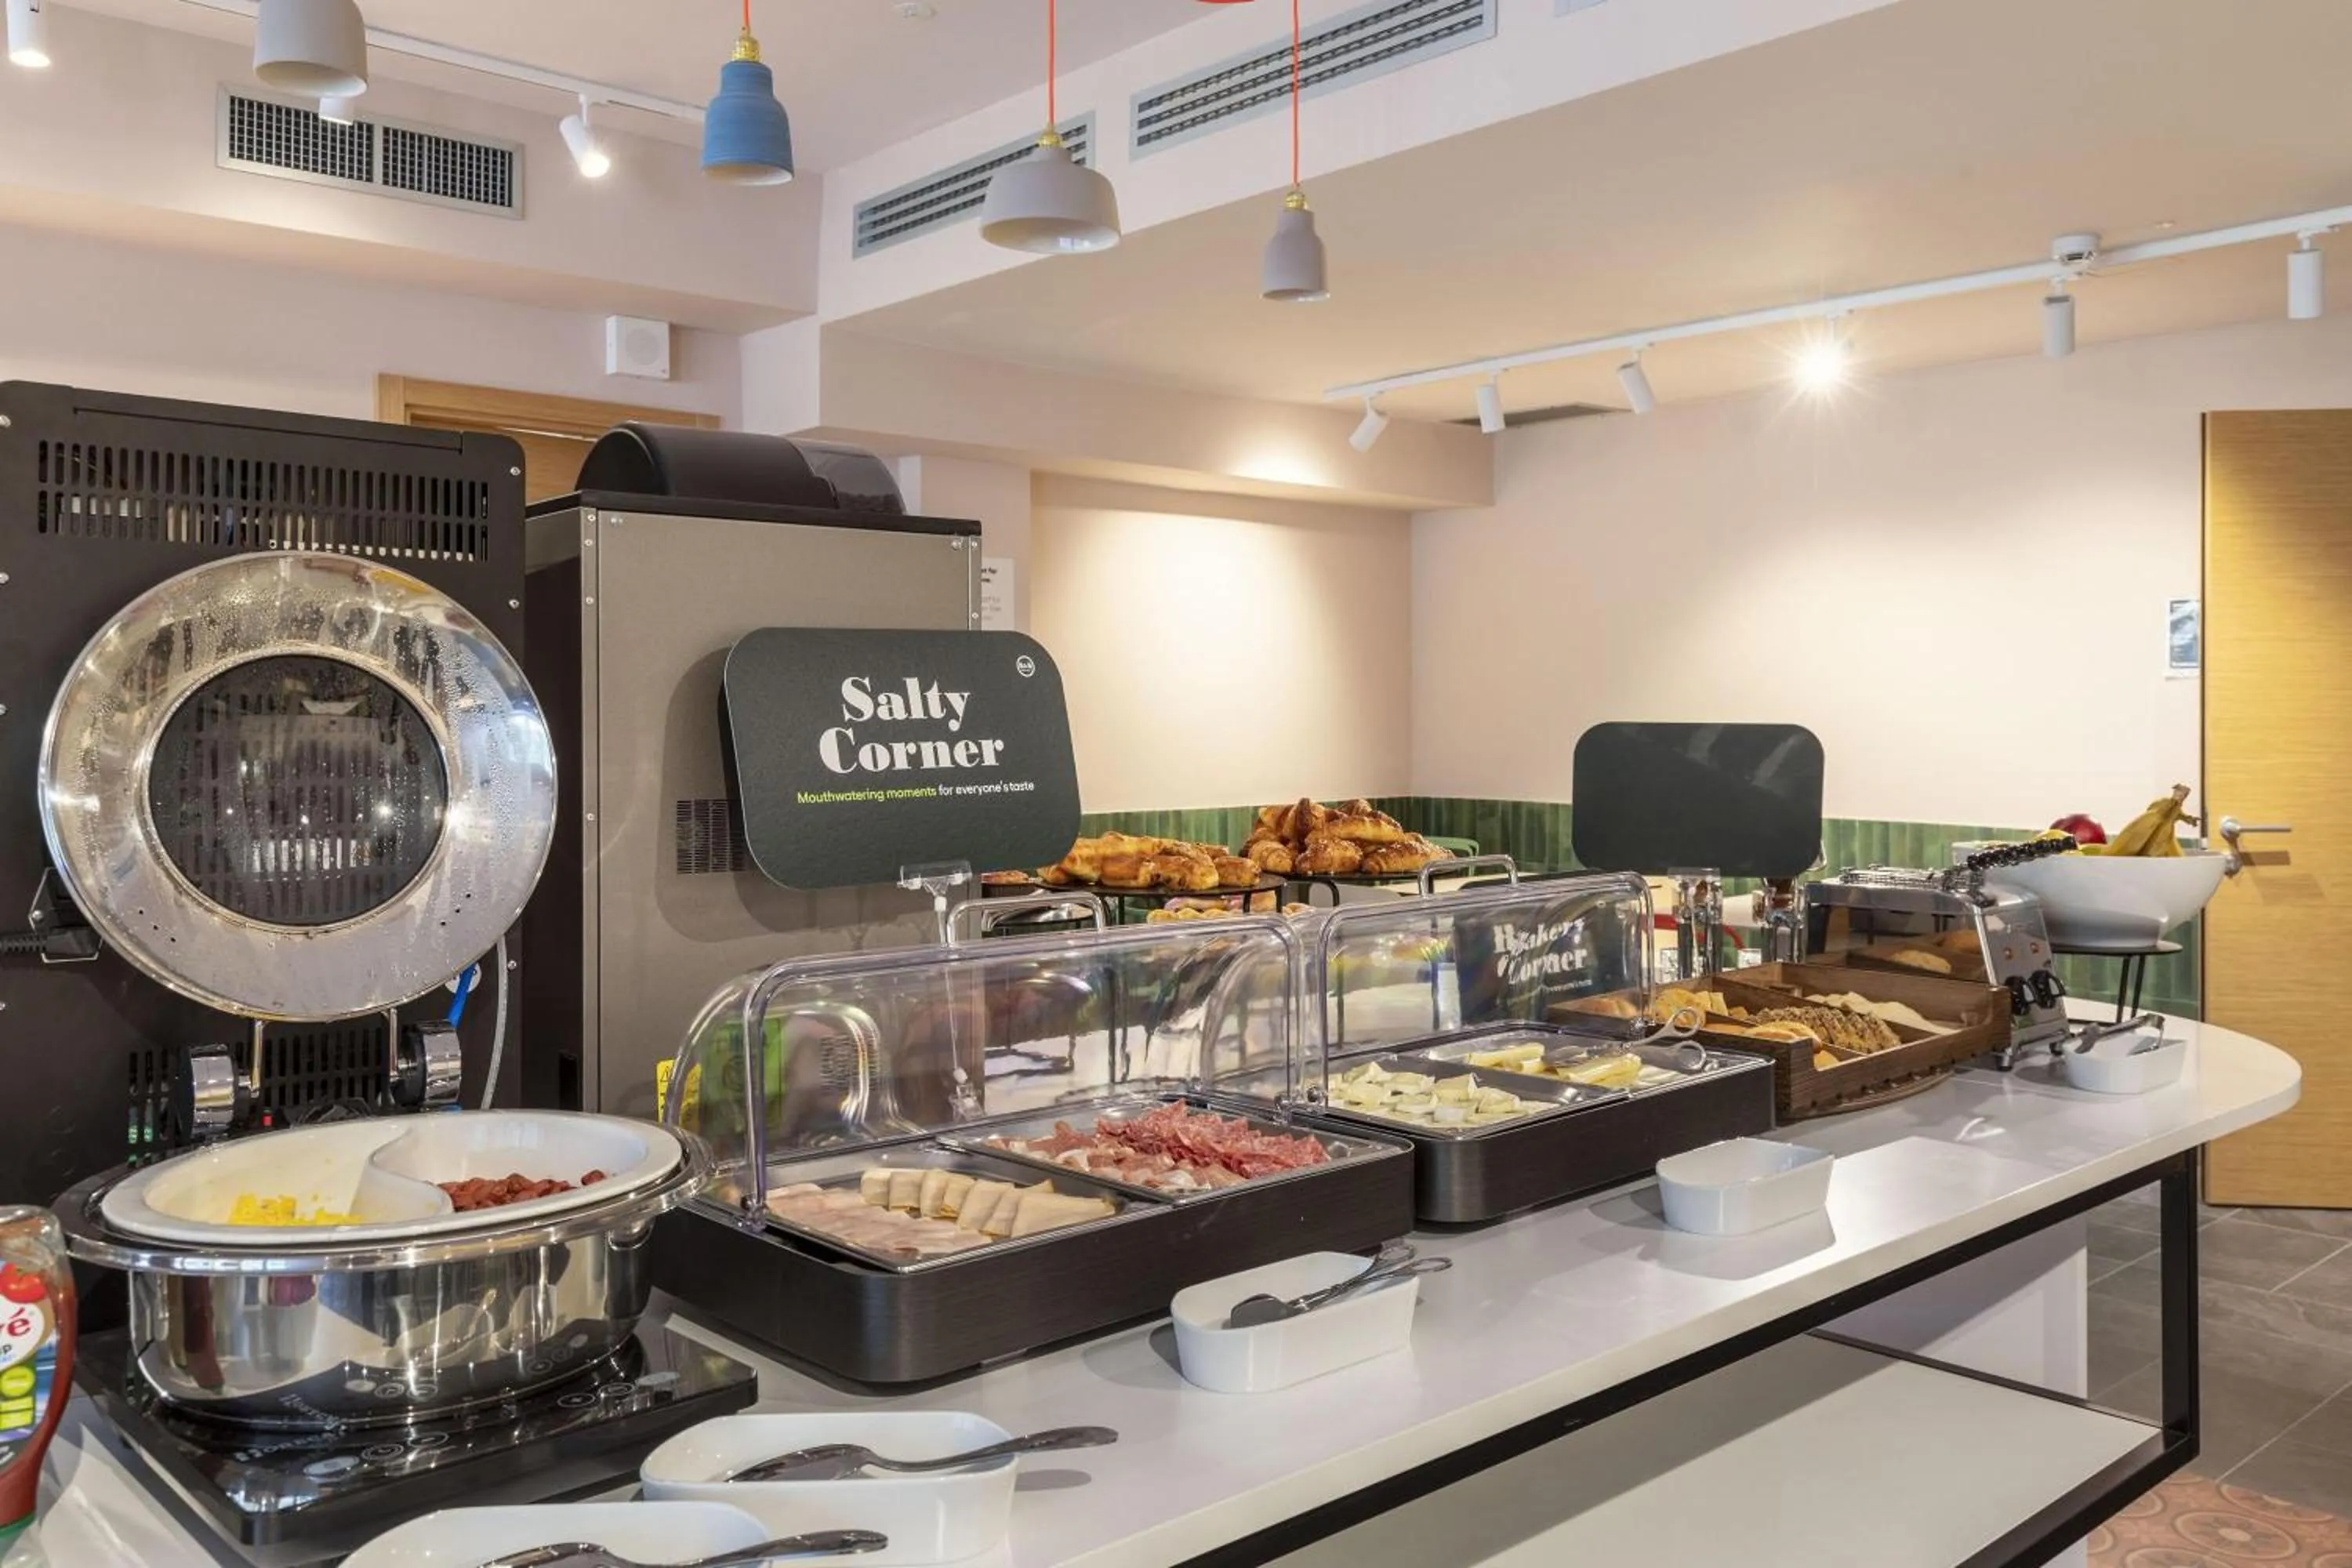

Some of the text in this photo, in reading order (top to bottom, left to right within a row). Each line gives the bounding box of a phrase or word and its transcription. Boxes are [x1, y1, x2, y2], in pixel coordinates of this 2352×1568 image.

[841, 677, 970, 731] Salty
[819, 728, 1004, 774] Corner
[797, 780, 1034, 804] Mouthwatering moments for everyone's taste
